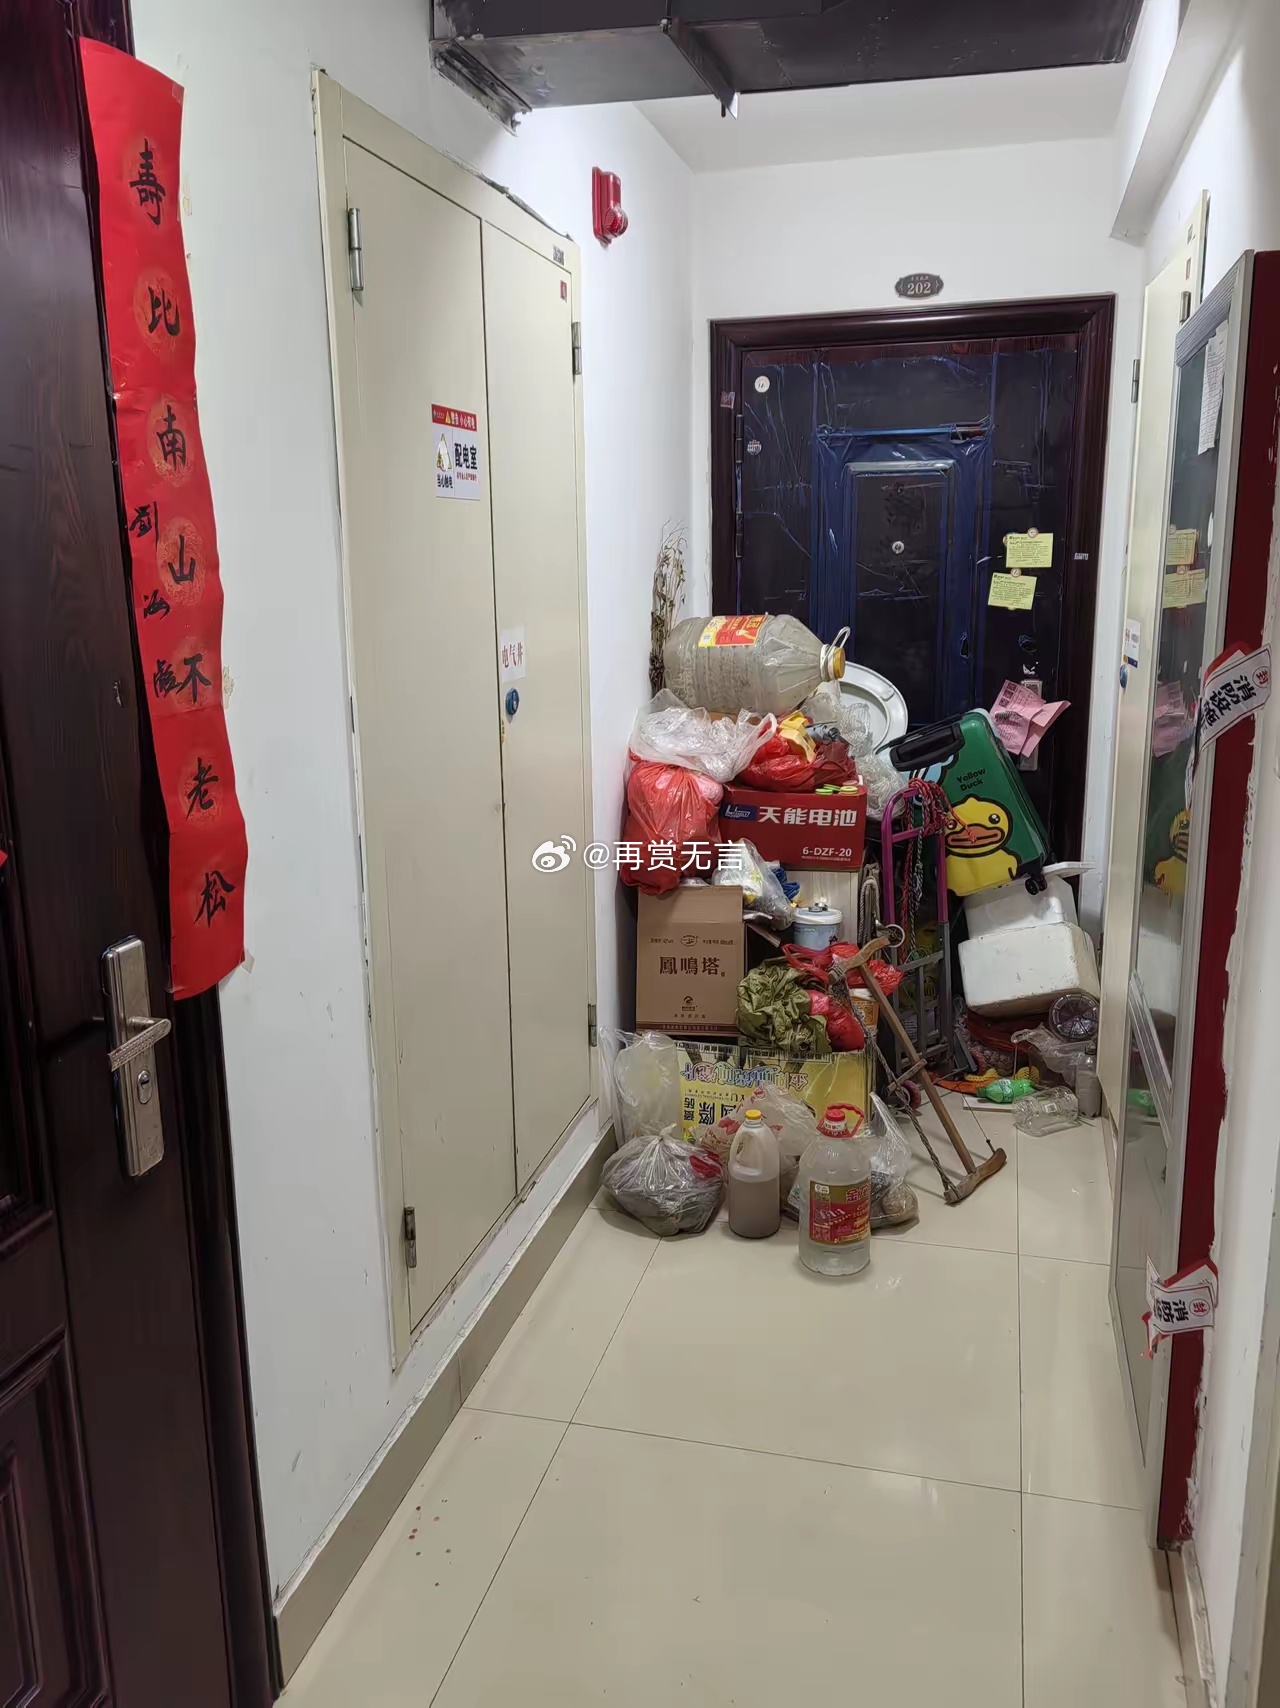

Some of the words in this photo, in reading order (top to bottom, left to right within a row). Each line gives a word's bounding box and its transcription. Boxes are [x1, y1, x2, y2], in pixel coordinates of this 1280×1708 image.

[907, 282, 931, 295] 202
[454, 442, 478, 470] 配电室
[502, 641, 523, 668] 电气井
[957, 768, 986, 783] Yellow
[960, 778, 984, 791] Duck
[758, 806, 857, 827] 天能电池
[802, 847, 852, 857] 6-DZF-20
[659, 956, 720, 976] 鳳鳴塔
